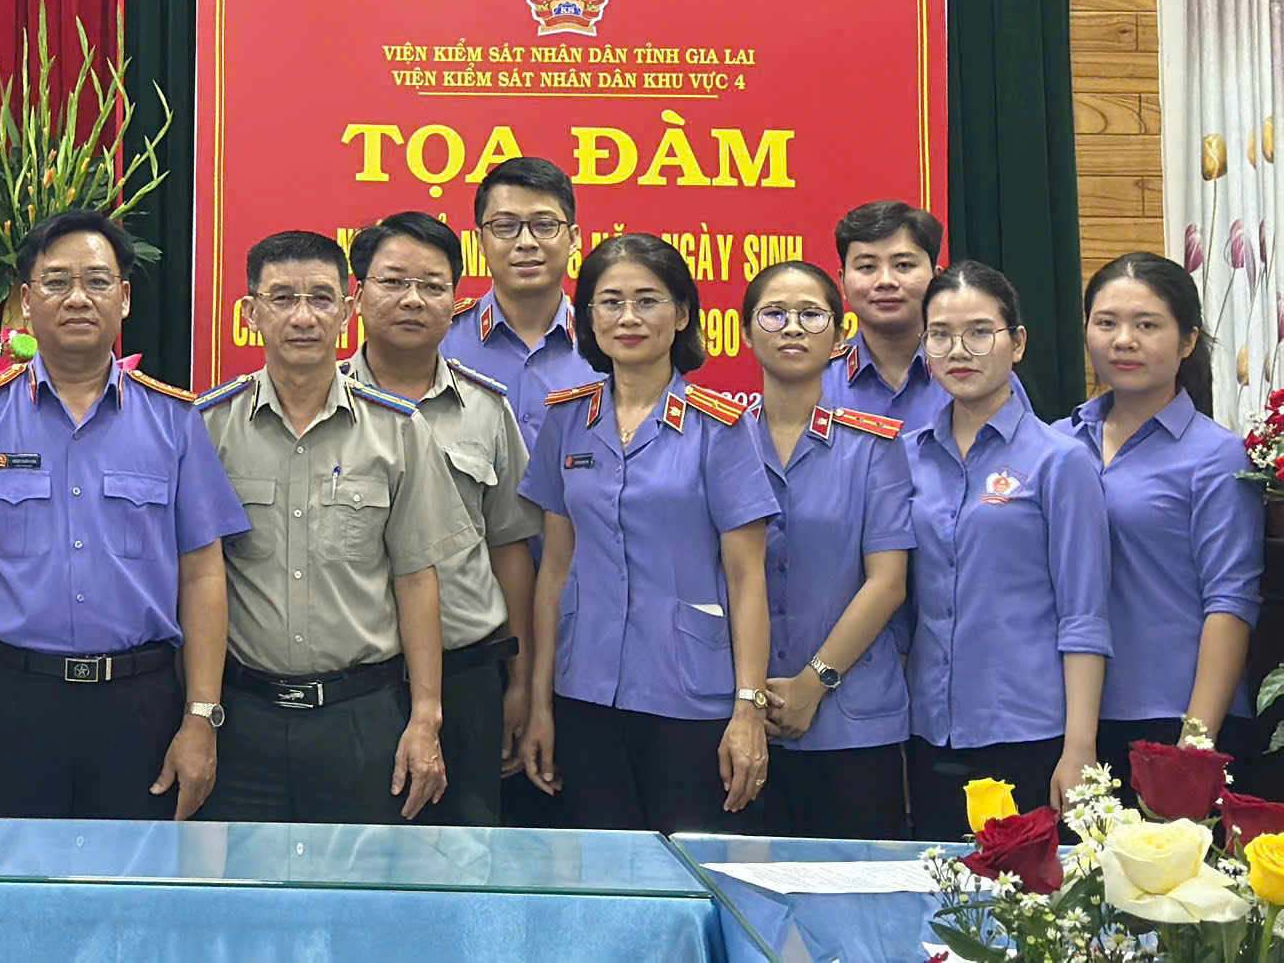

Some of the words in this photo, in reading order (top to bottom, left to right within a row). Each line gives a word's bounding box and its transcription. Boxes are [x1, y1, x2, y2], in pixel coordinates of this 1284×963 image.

[382, 41, 428, 64] VIỆN
[433, 38, 483, 63] KIỂM
[488, 42, 525, 63] SÁT
[530, 43, 583, 63] NHÂN
[588, 44, 628, 64] DÂN
[633, 42, 679, 64] TỈNH
[685, 48, 719, 64] GIA
[724, 49, 755, 65] LAI
[391, 66, 437, 89] VIỆN
[443, 62, 492, 87] KIỂM
[498, 68, 534, 87] SÁT
[540, 68, 592, 88] NHÂN
[598, 68, 637, 88] DÂN
[643, 72, 683, 89] KHU
[689, 70, 729, 92] VỰC
[734, 74, 746, 90] 4
[341, 123, 524, 198] TỌA
[571, 109, 796, 188] ĐÀM
